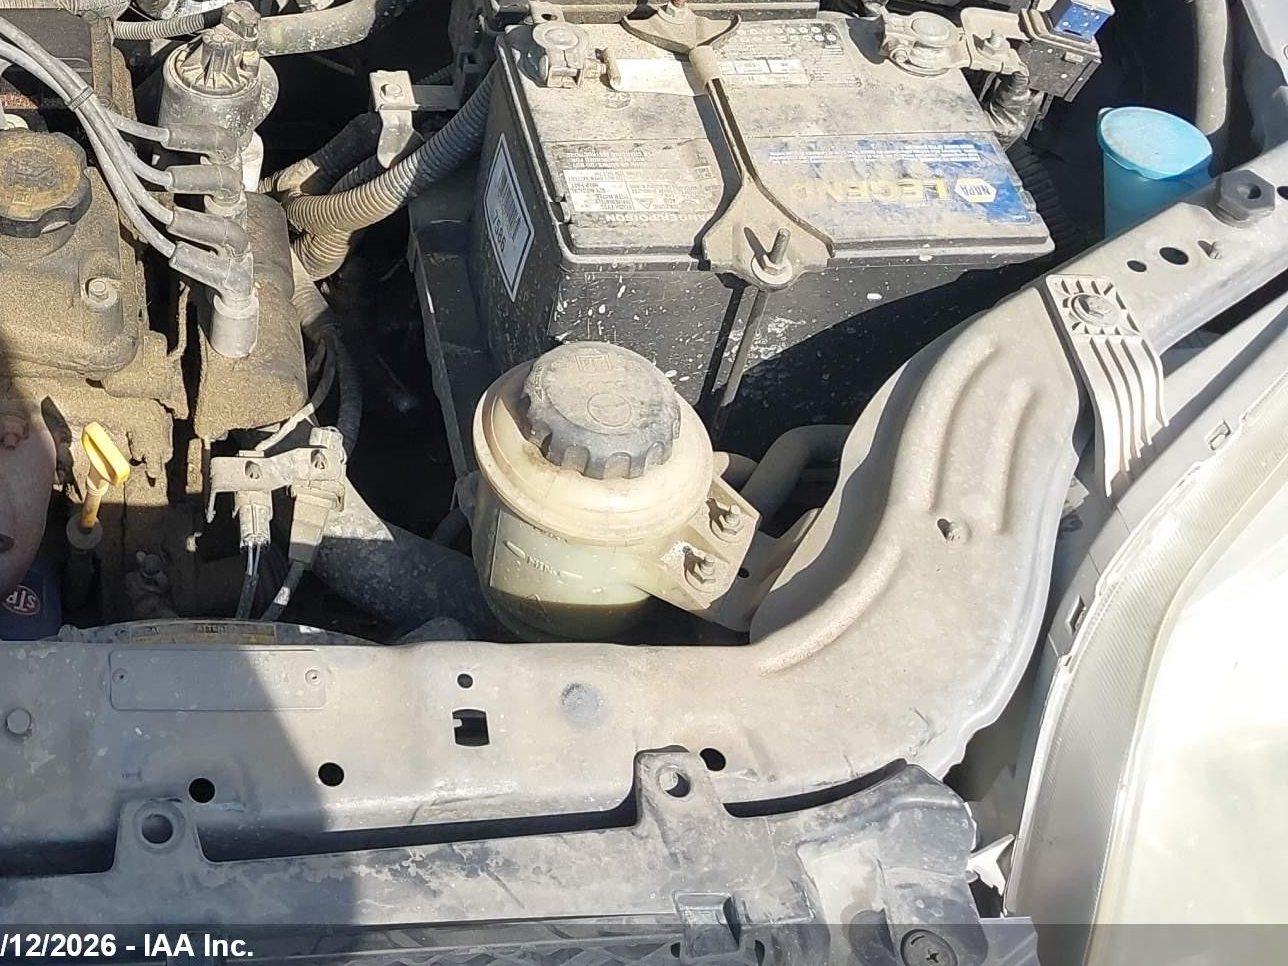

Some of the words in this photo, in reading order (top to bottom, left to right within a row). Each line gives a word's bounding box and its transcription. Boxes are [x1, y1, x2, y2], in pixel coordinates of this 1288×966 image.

[793, 177, 950, 202] LEGEND
[960, 185, 991, 197] NAPA
[491, 209, 506, 253] 7586
[5, 590, 37, 612] STP
